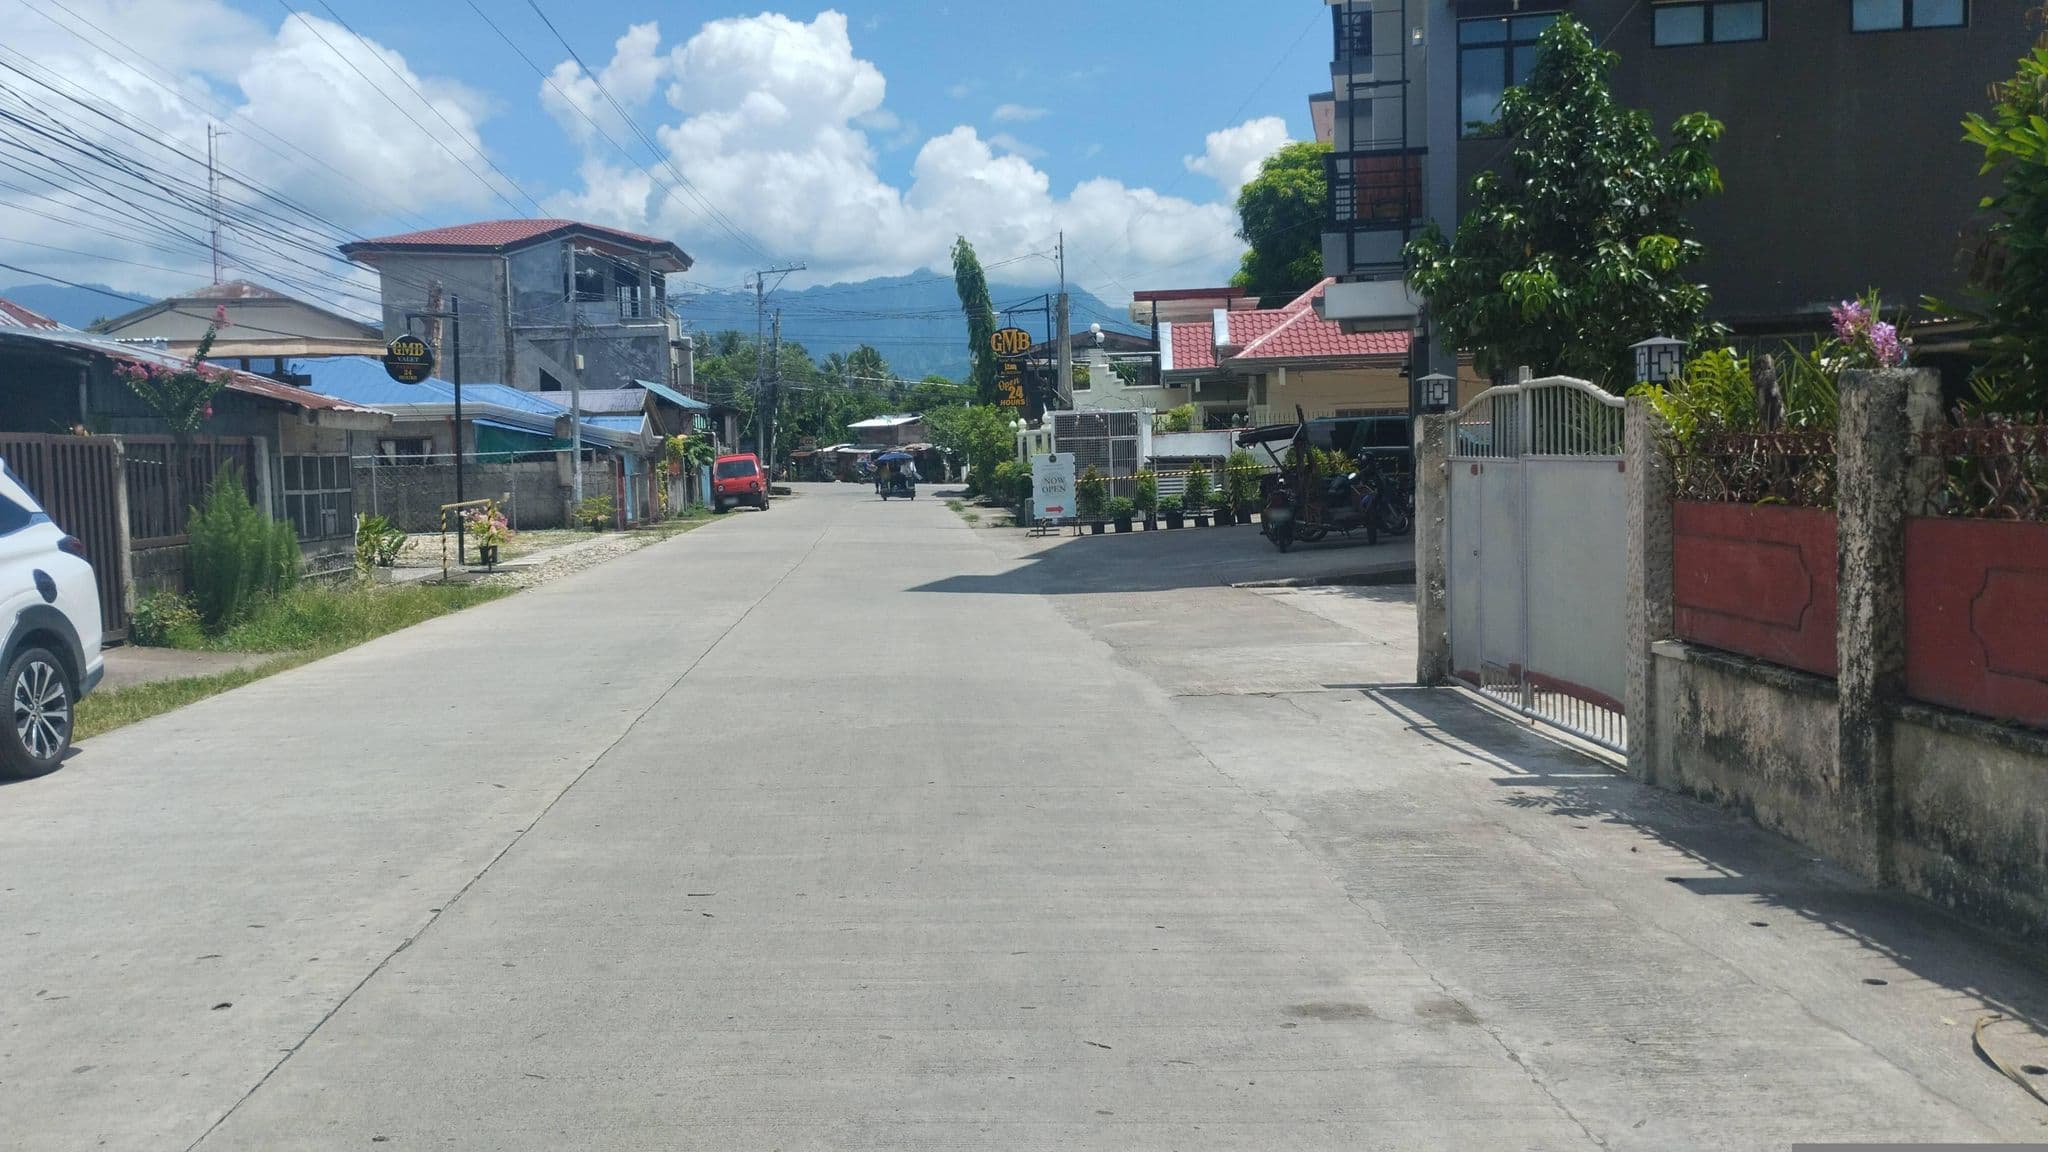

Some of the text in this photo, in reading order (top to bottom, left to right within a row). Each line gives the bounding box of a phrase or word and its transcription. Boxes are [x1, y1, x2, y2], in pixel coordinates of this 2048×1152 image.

[392, 341, 424, 356] GMB
[991, 329, 1031, 354] GMB
[998, 377, 1019, 391] Open
[1008, 385, 1024, 399] 24
[1043, 477, 1065, 485] NOW
